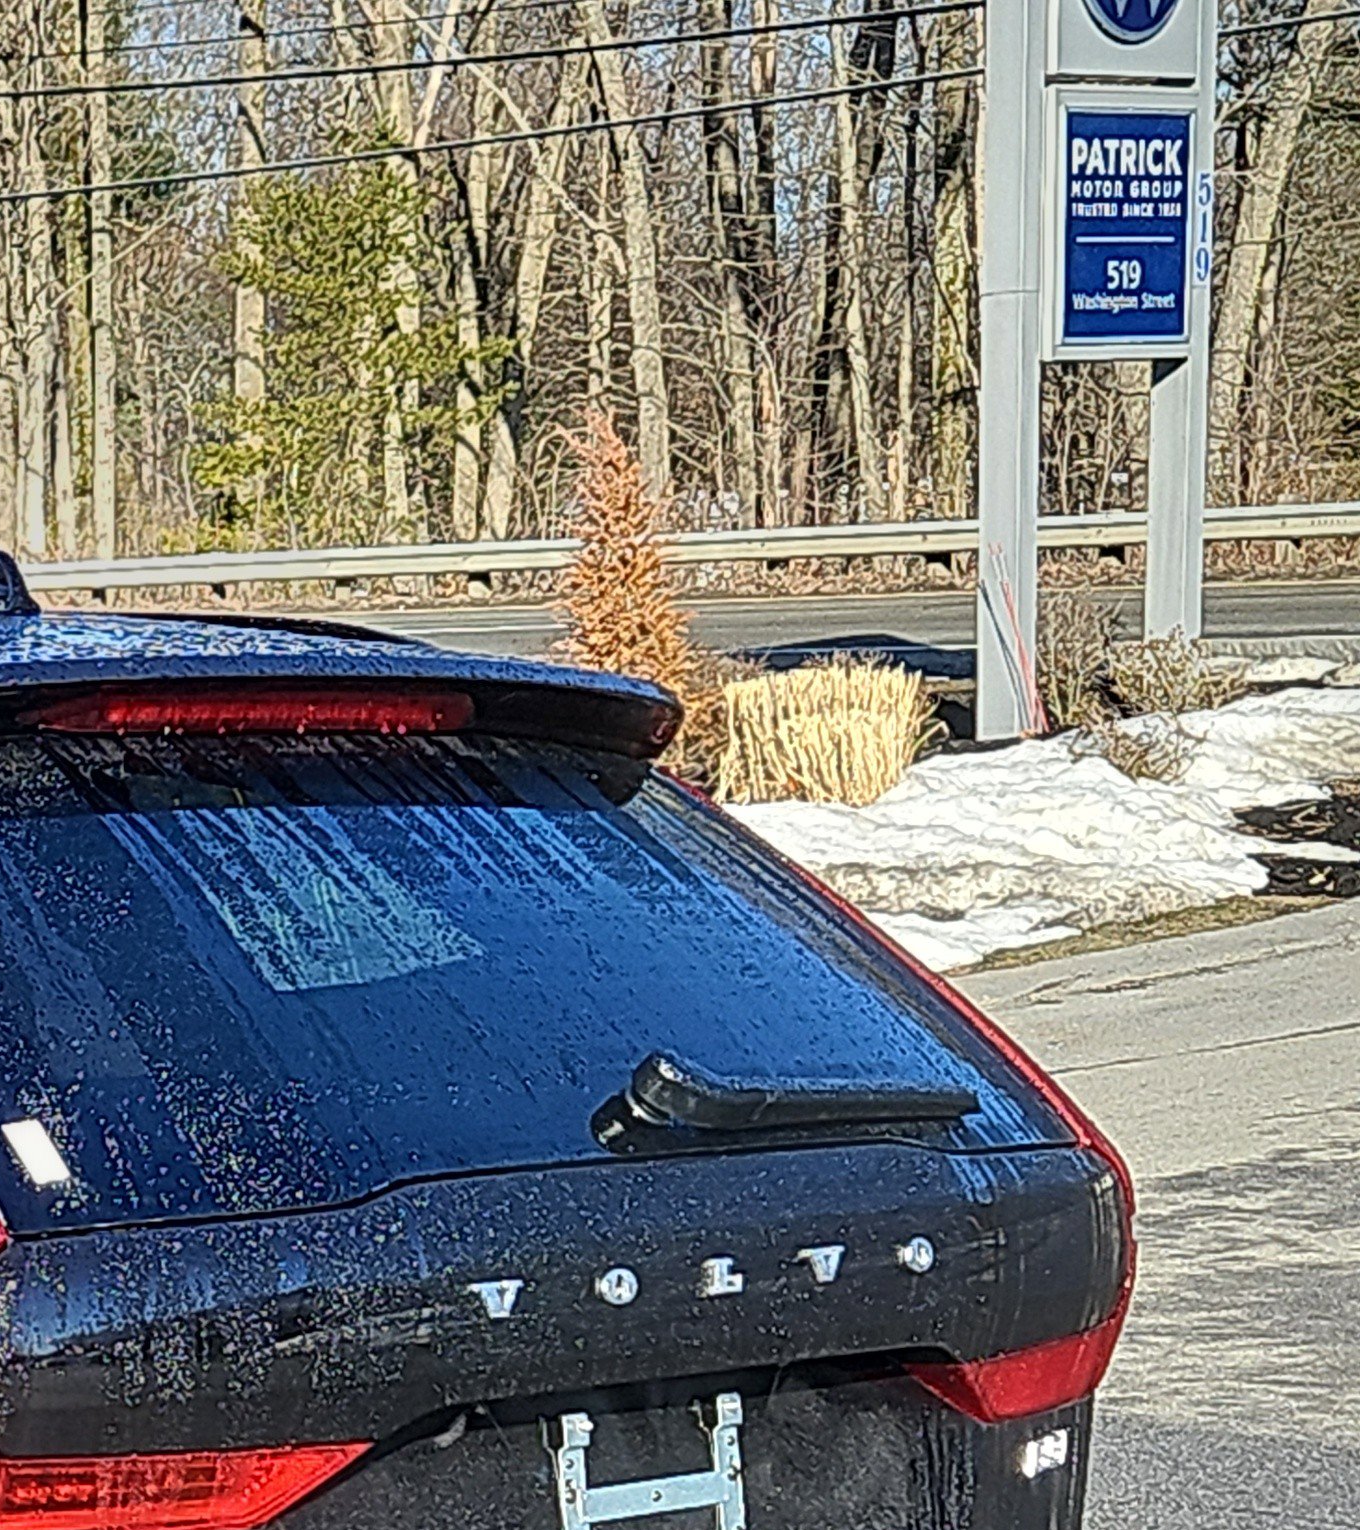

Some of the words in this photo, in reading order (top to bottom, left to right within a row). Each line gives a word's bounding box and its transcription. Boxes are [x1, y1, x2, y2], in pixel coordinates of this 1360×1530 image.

[1072, 138, 1183, 175] PATRICK
[1071, 180, 1125, 198] MOTOR
[1129, 180, 1183, 198] GROUP
[1106, 259, 1142, 290] 519
[1072, 292, 1138, 314] Washington
[1140, 292, 1176, 309] Street
[468, 1235, 935, 1318] VOLVO
